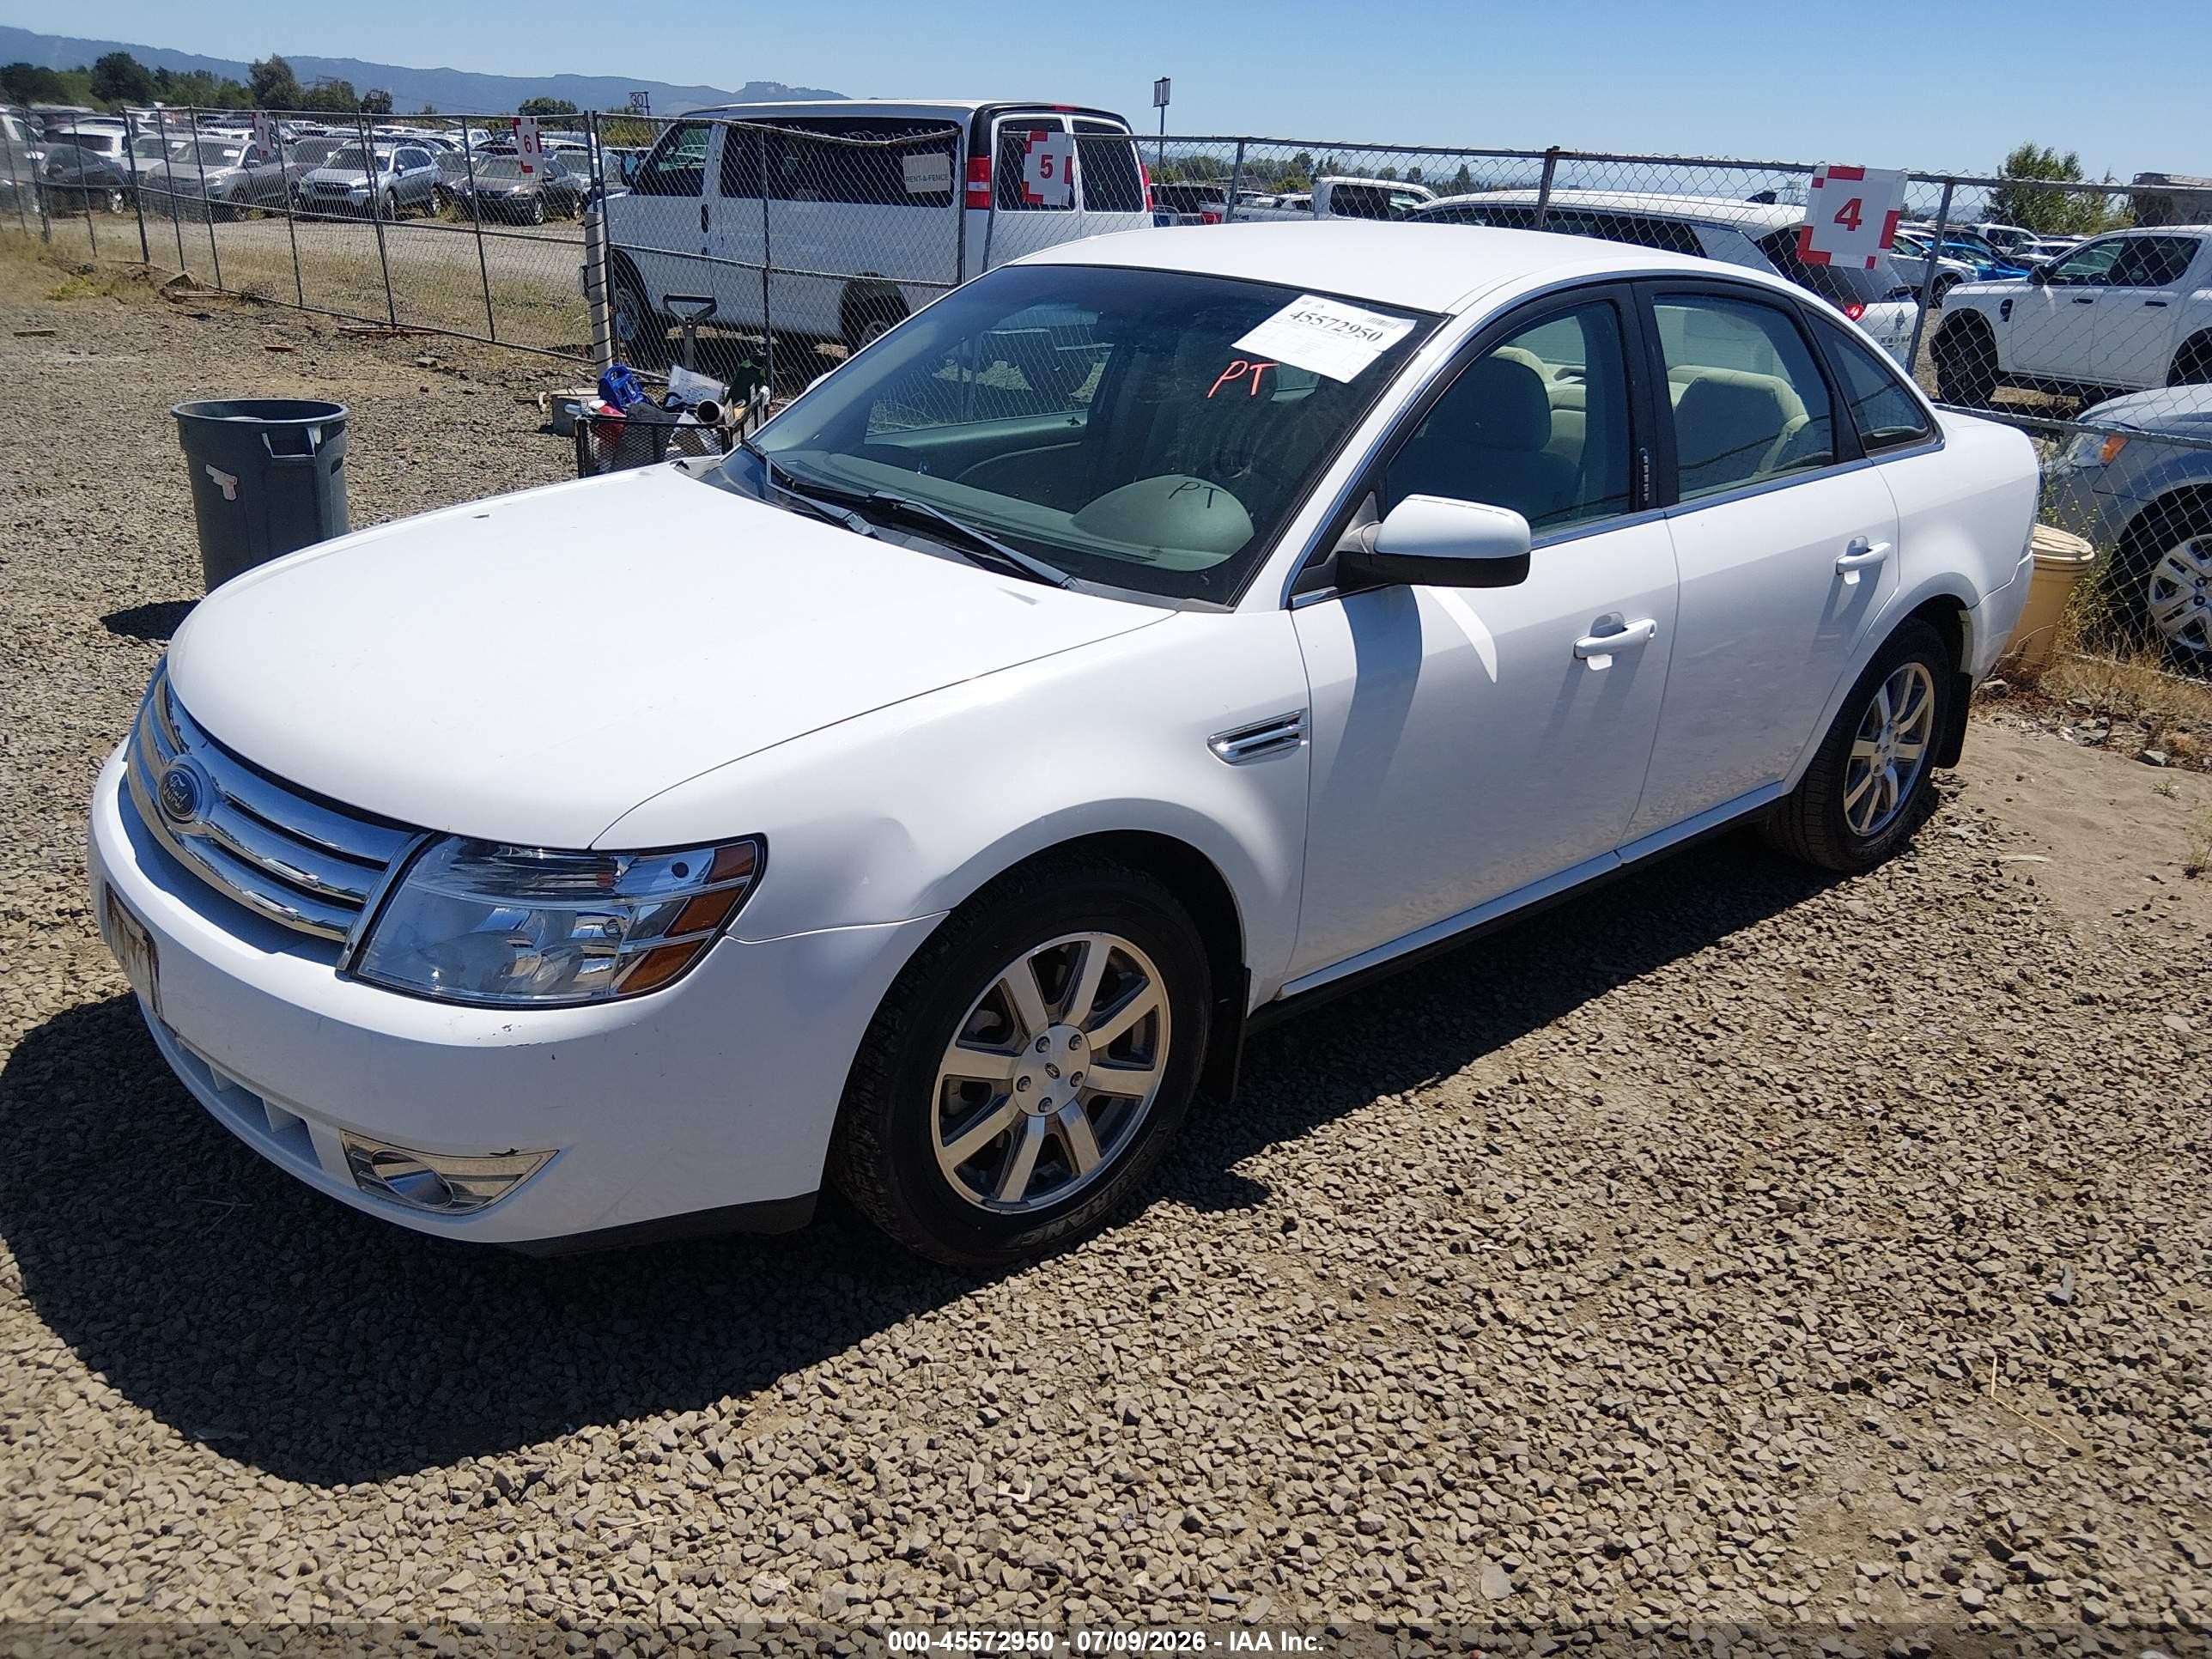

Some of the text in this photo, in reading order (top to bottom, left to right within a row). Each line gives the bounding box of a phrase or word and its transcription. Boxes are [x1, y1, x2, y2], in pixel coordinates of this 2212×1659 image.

[631, 94, 644, 106] 30
[524, 134, 532, 154] 6
[1040, 155, 1054, 179] 5
[1834, 198, 1863, 231] 4
[1289, 309, 1384, 343] 45572950
[1207, 361, 1280, 398] PT
[1169, 481, 1228, 508] PT
[163, 774, 188, 809] Ford
